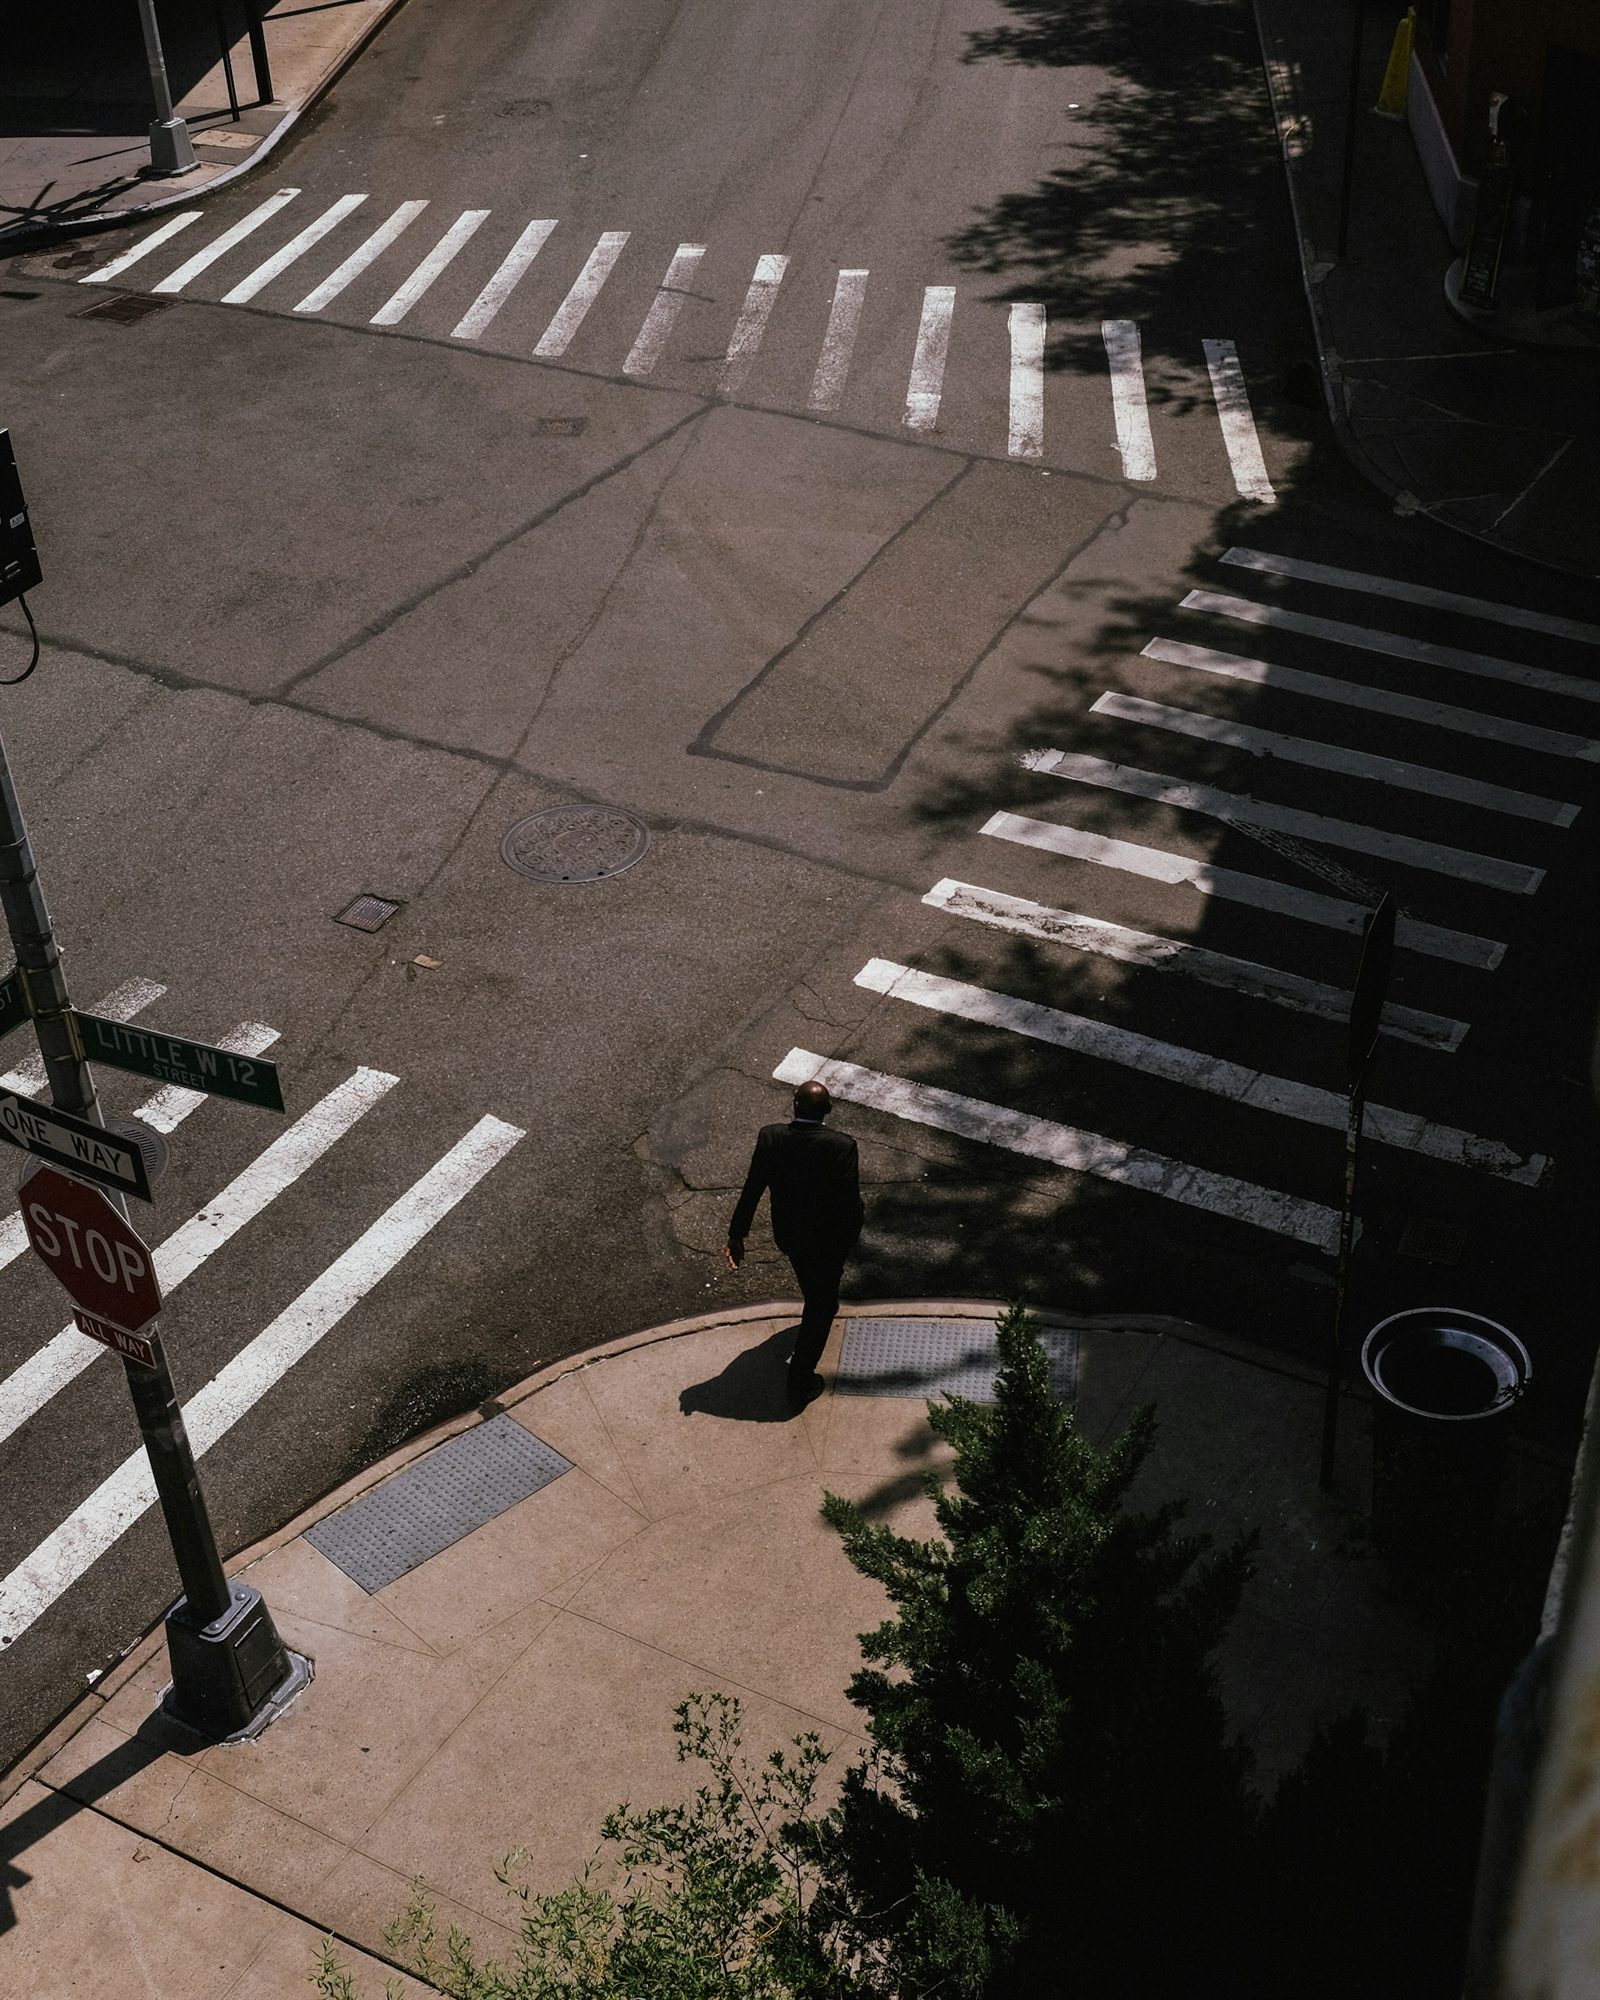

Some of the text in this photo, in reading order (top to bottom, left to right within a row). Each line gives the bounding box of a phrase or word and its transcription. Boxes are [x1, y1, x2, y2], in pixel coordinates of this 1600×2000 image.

[95, 1021, 258, 1088] LITTLE W 12
[152, 1062, 207, 1089] STREET
[3, 1107, 120, 1173] ONE WAY
[29, 1203, 145, 1294] STOP
[81, 1316, 145, 1358] ALL WAY
